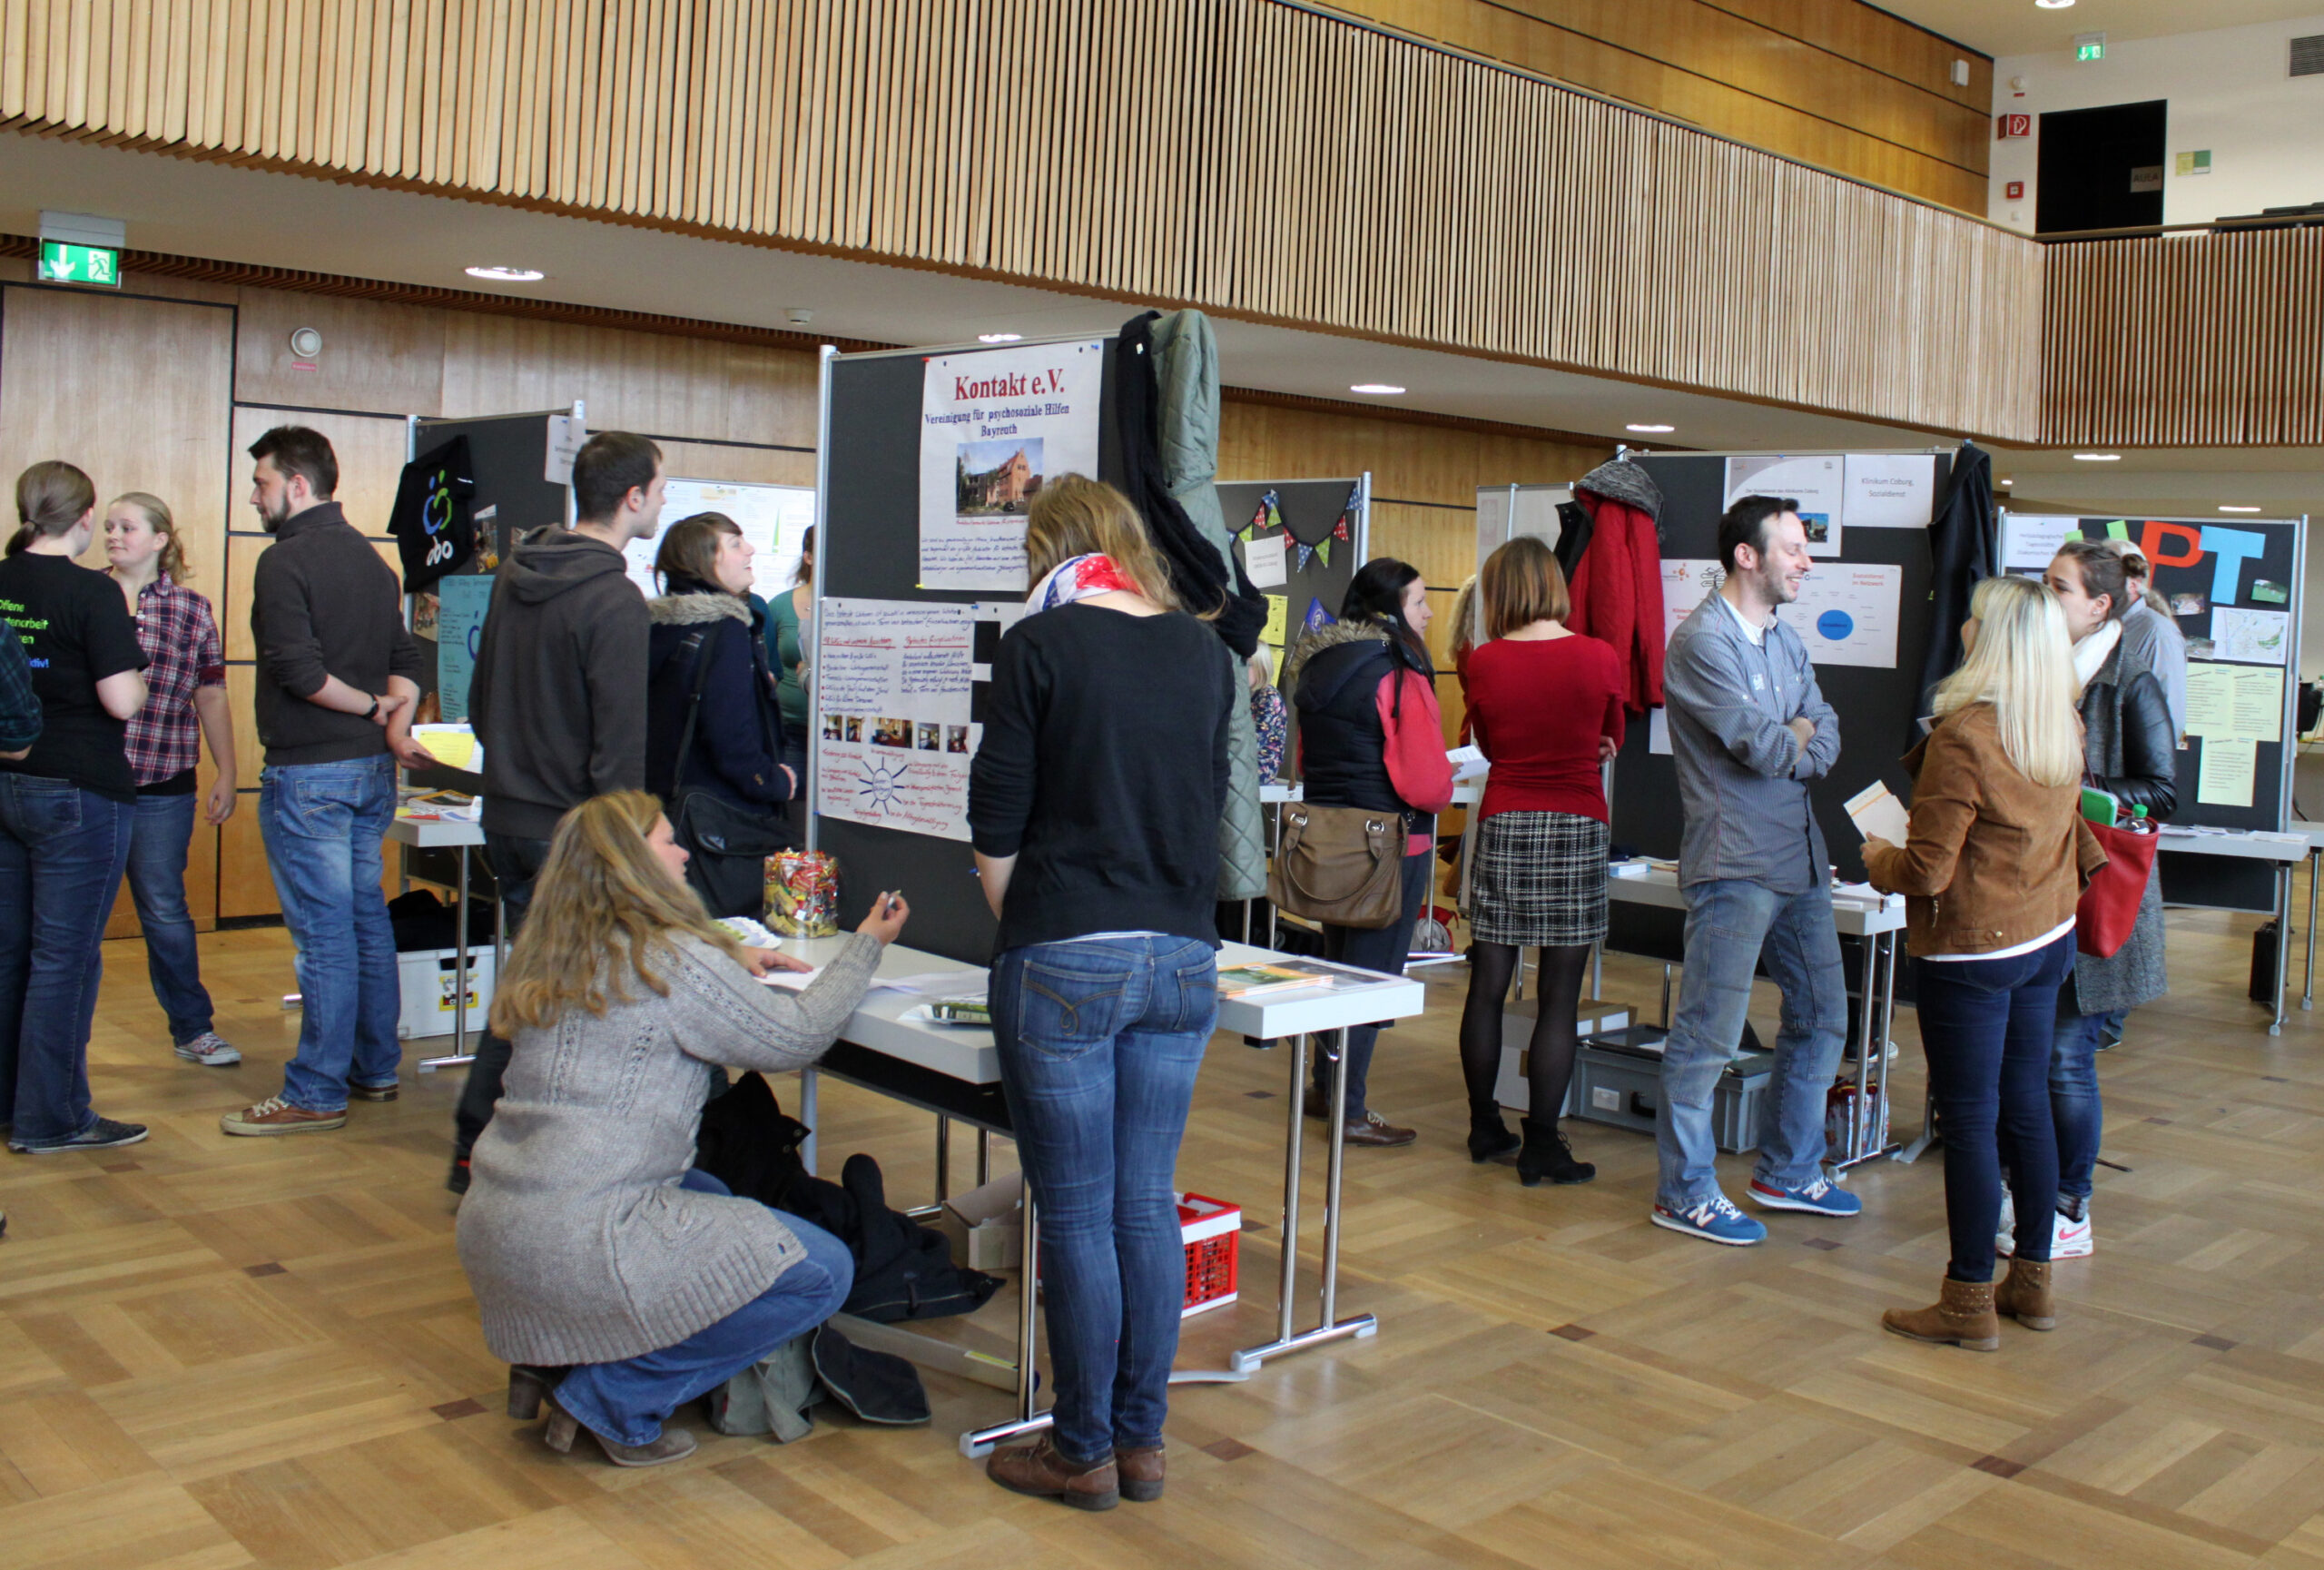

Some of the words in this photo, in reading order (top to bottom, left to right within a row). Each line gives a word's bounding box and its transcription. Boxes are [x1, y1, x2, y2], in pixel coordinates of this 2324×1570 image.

[954, 372, 1028, 400] Kontakt
[1031, 369, 1065, 395] e.V.
[925, 411, 971, 425] Vereinigung
[972, 409, 985, 420] für
[989, 404, 1042, 421] psychosoziale
[1044, 403, 1070, 416] Hilfen
[980, 423, 1018, 438] Bayreuth
[1861, 477, 1888, 486] Klinikum
[1889, 477, 1915, 488] Coburg,
[1867, 489, 1906, 498] Sozialdienst
[4, 617, 50, 630] tenarbeit
[1687, 1201, 1718, 1228] N
